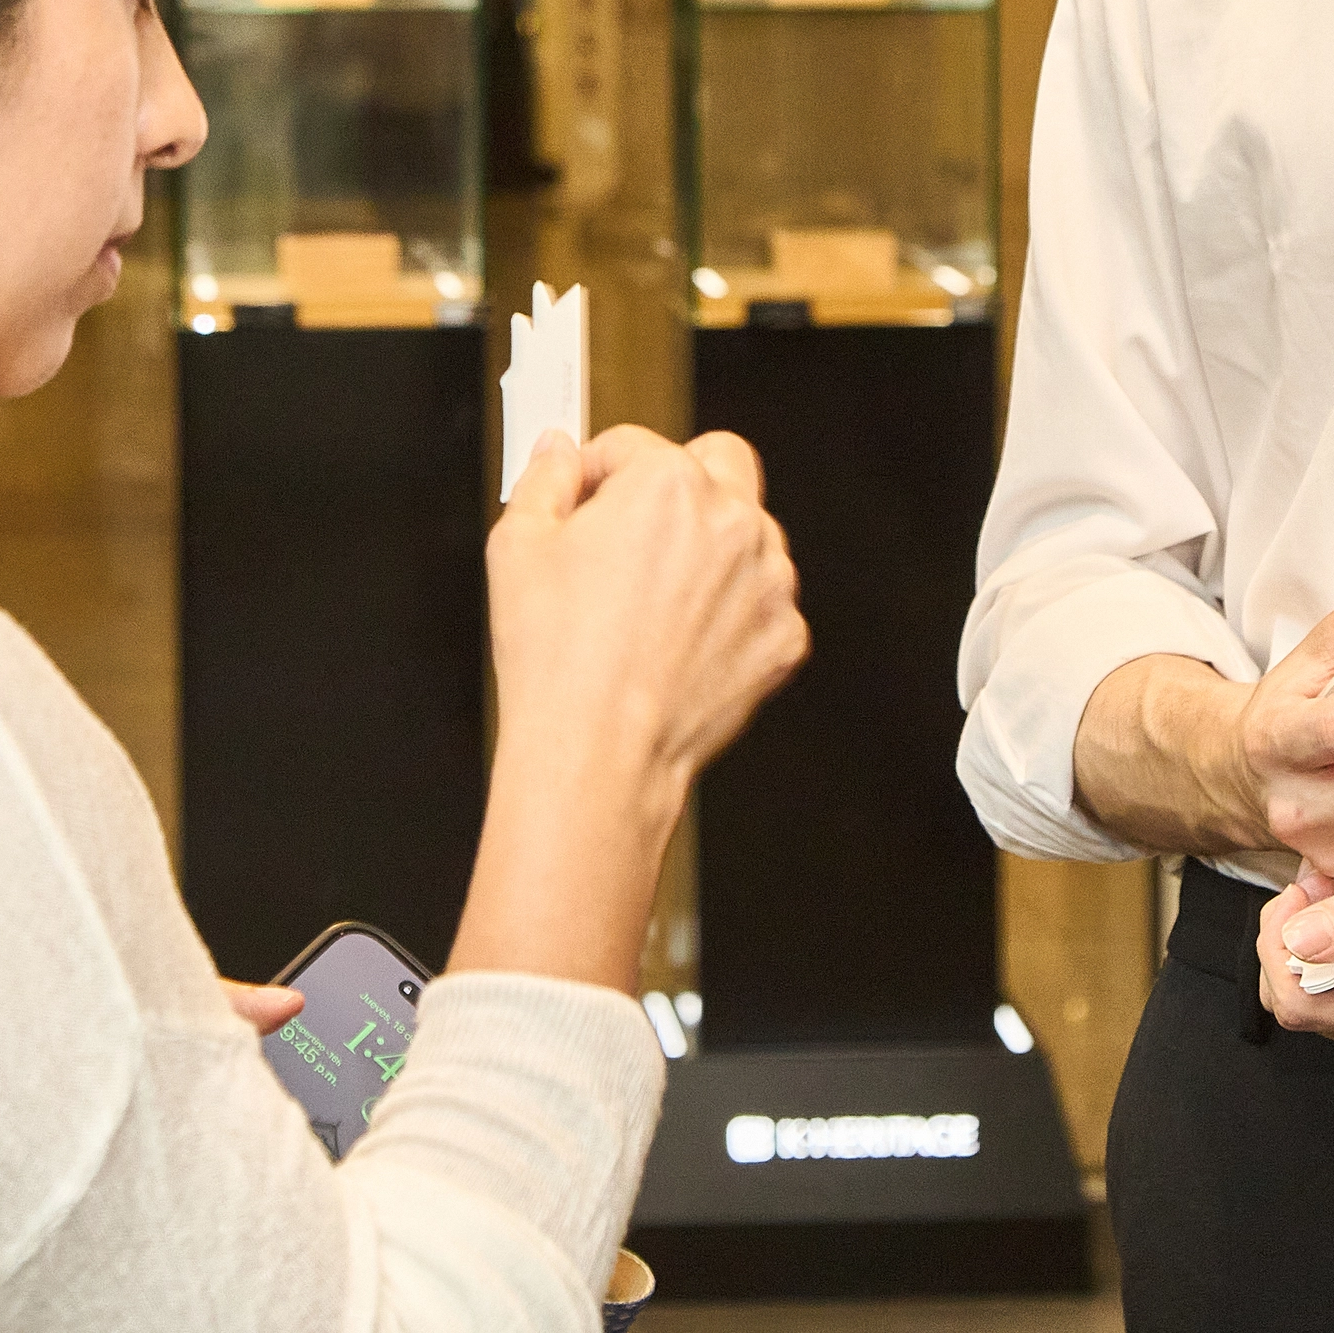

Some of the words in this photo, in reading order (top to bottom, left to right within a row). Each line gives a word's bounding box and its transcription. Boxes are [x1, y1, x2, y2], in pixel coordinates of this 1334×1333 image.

[290, 1018, 326, 1053] Cupertino
[359, 992, 392, 1025] Jueves,
[393, 1020, 406, 1036] 18
[279, 1025, 321, 1065] 9:45
[313, 1062, 338, 1088] p.m.
[343, 1020, 408, 1083] 1:4
